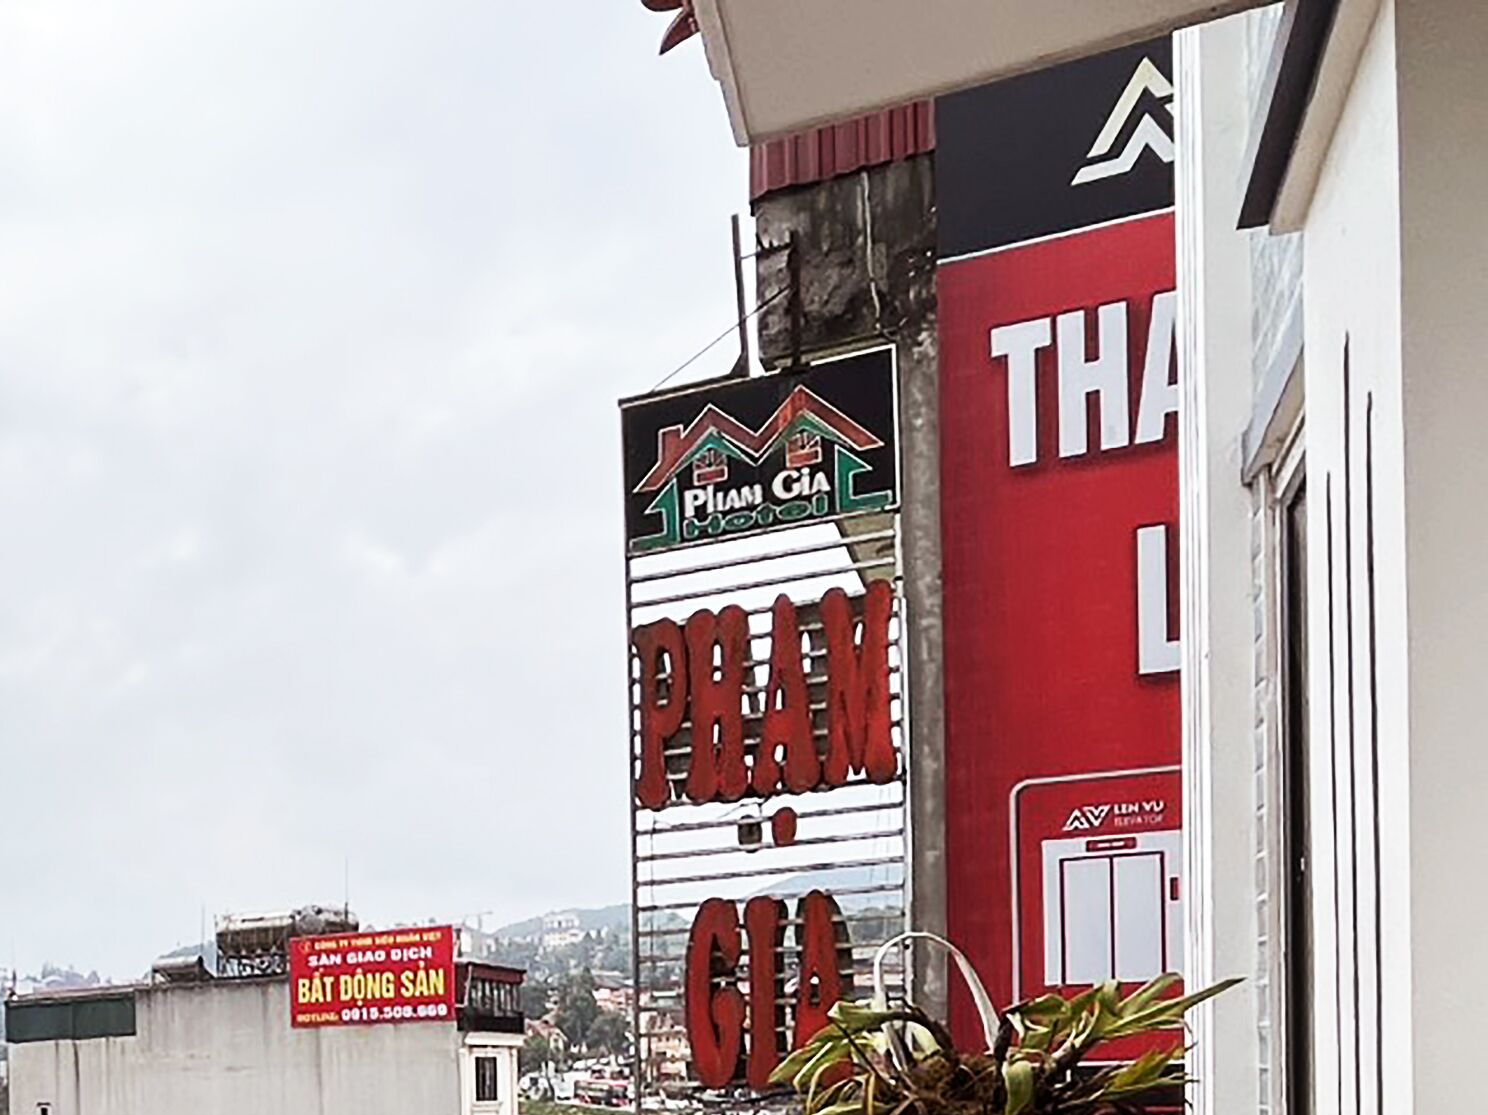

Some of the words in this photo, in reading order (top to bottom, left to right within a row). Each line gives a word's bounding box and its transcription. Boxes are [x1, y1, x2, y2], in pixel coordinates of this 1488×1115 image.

[346, 948, 386, 964] GIAO
[339, 967, 395, 1006] ĐỘNG
[400, 960, 445, 998] SẢN
[685, 889, 853, 1090] GIA
